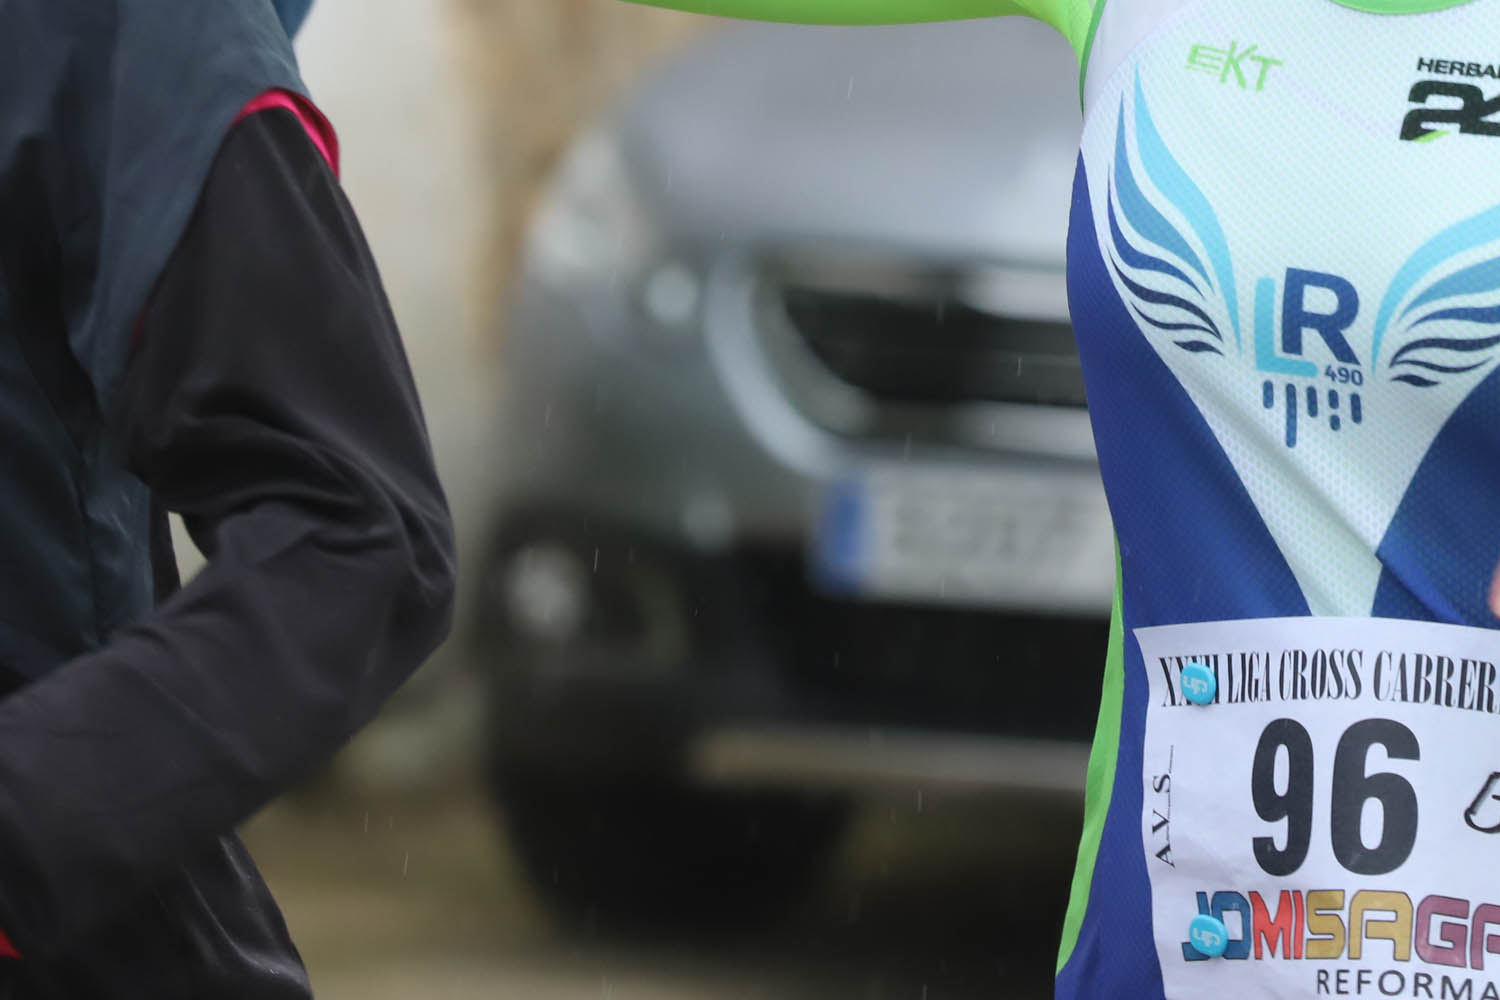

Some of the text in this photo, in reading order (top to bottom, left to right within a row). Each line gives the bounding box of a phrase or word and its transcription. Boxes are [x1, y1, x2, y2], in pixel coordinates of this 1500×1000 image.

[1184, 40, 1284, 92] EKT
[1253, 267, 1361, 378] LR
[1324, 363, 1364, 387] 490
[1226, 649, 1272, 704] LIGA
[1279, 648, 1363, 701] CROSS
[1251, 718, 1420, 877] 96
